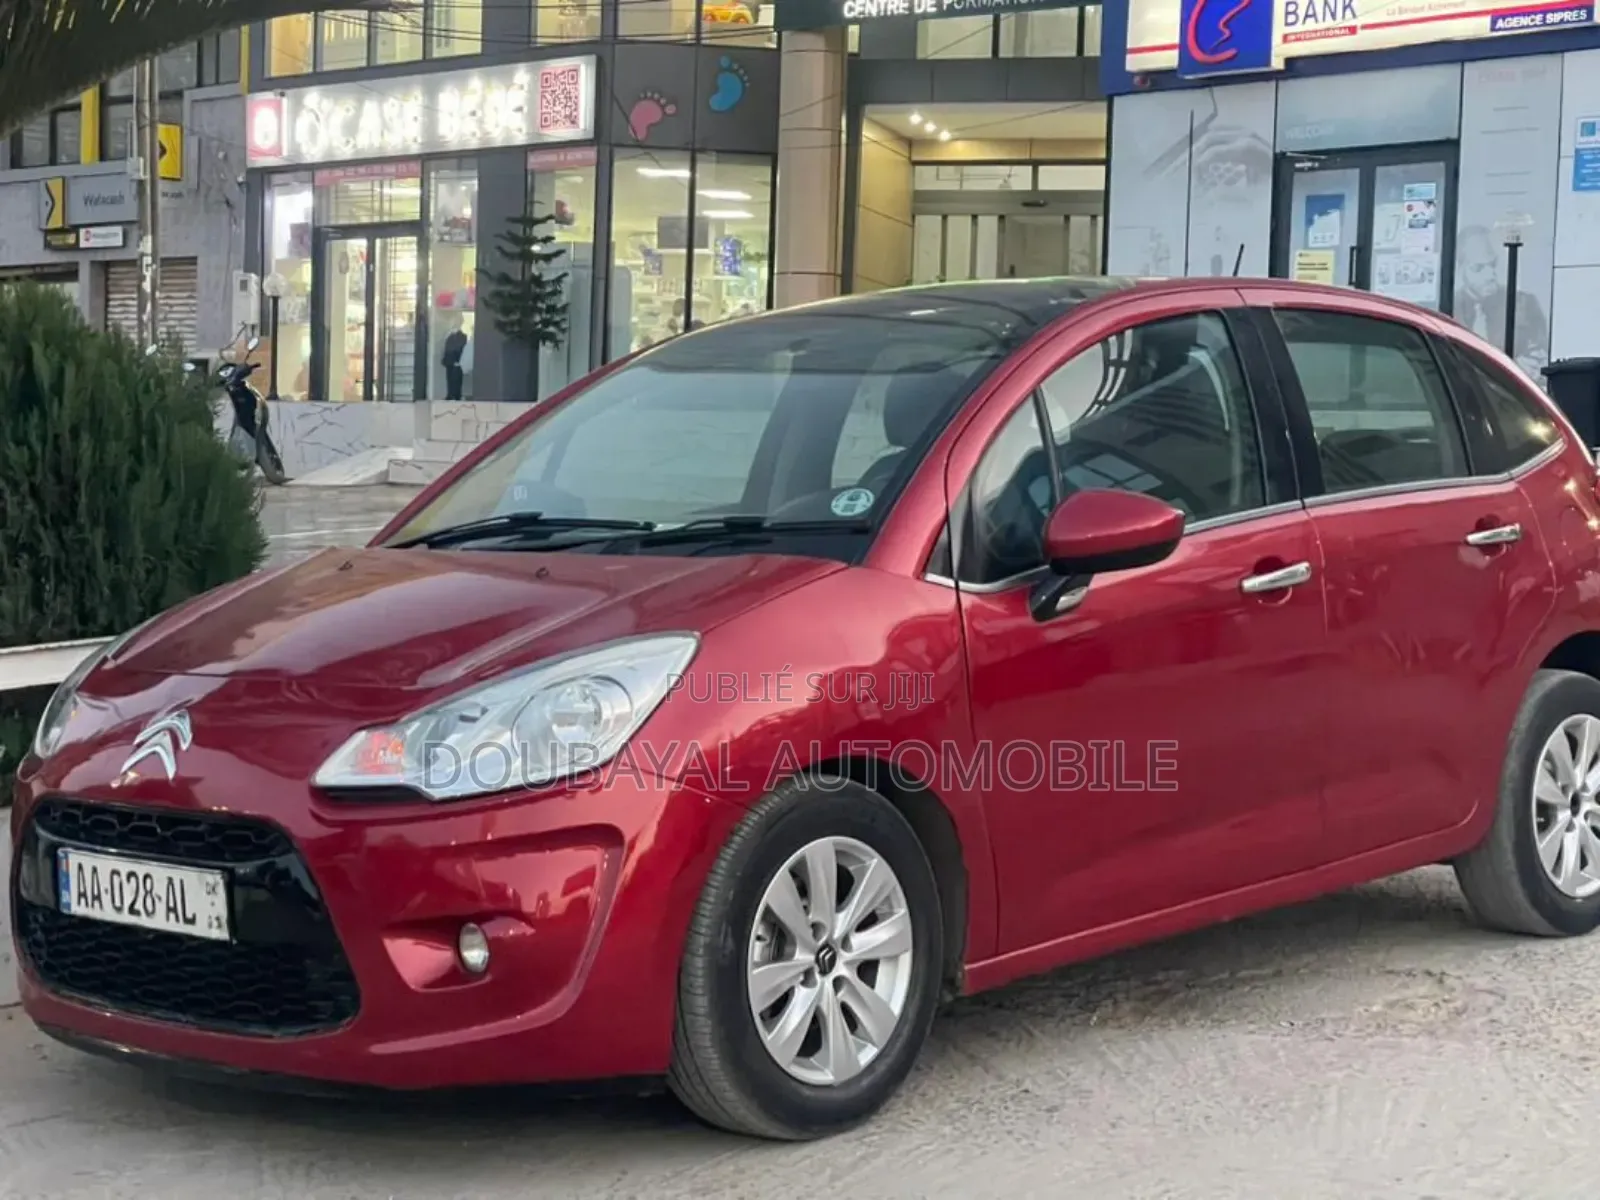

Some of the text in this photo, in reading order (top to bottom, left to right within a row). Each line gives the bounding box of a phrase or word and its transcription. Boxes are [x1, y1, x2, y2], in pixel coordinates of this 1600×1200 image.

[844, 0, 909, 18] CENTRE
[1285, 0, 1356, 26] BANK
[1495, 10, 1587, 29] AGENCE SIPRES
